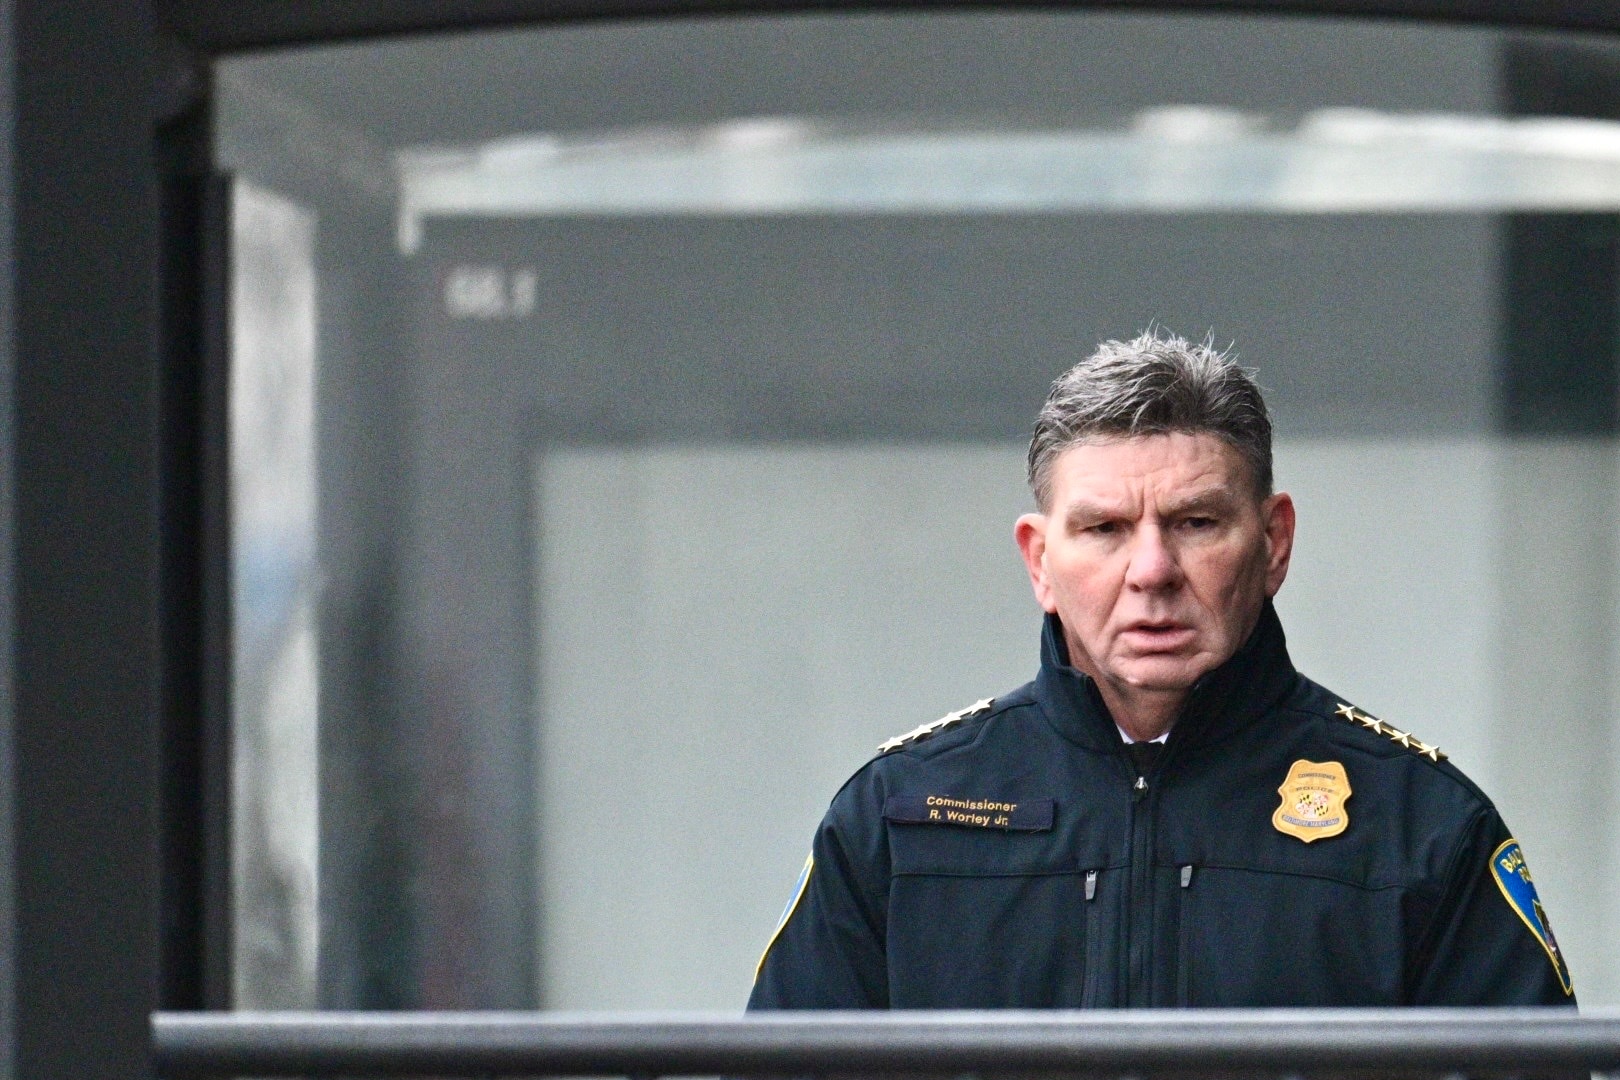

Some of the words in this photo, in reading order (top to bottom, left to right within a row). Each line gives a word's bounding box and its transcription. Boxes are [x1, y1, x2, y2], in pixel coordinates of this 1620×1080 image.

[926, 795, 1017, 812] Commissioner
[929, 809, 942, 820] R.
[947, 810, 990, 827] Worley
